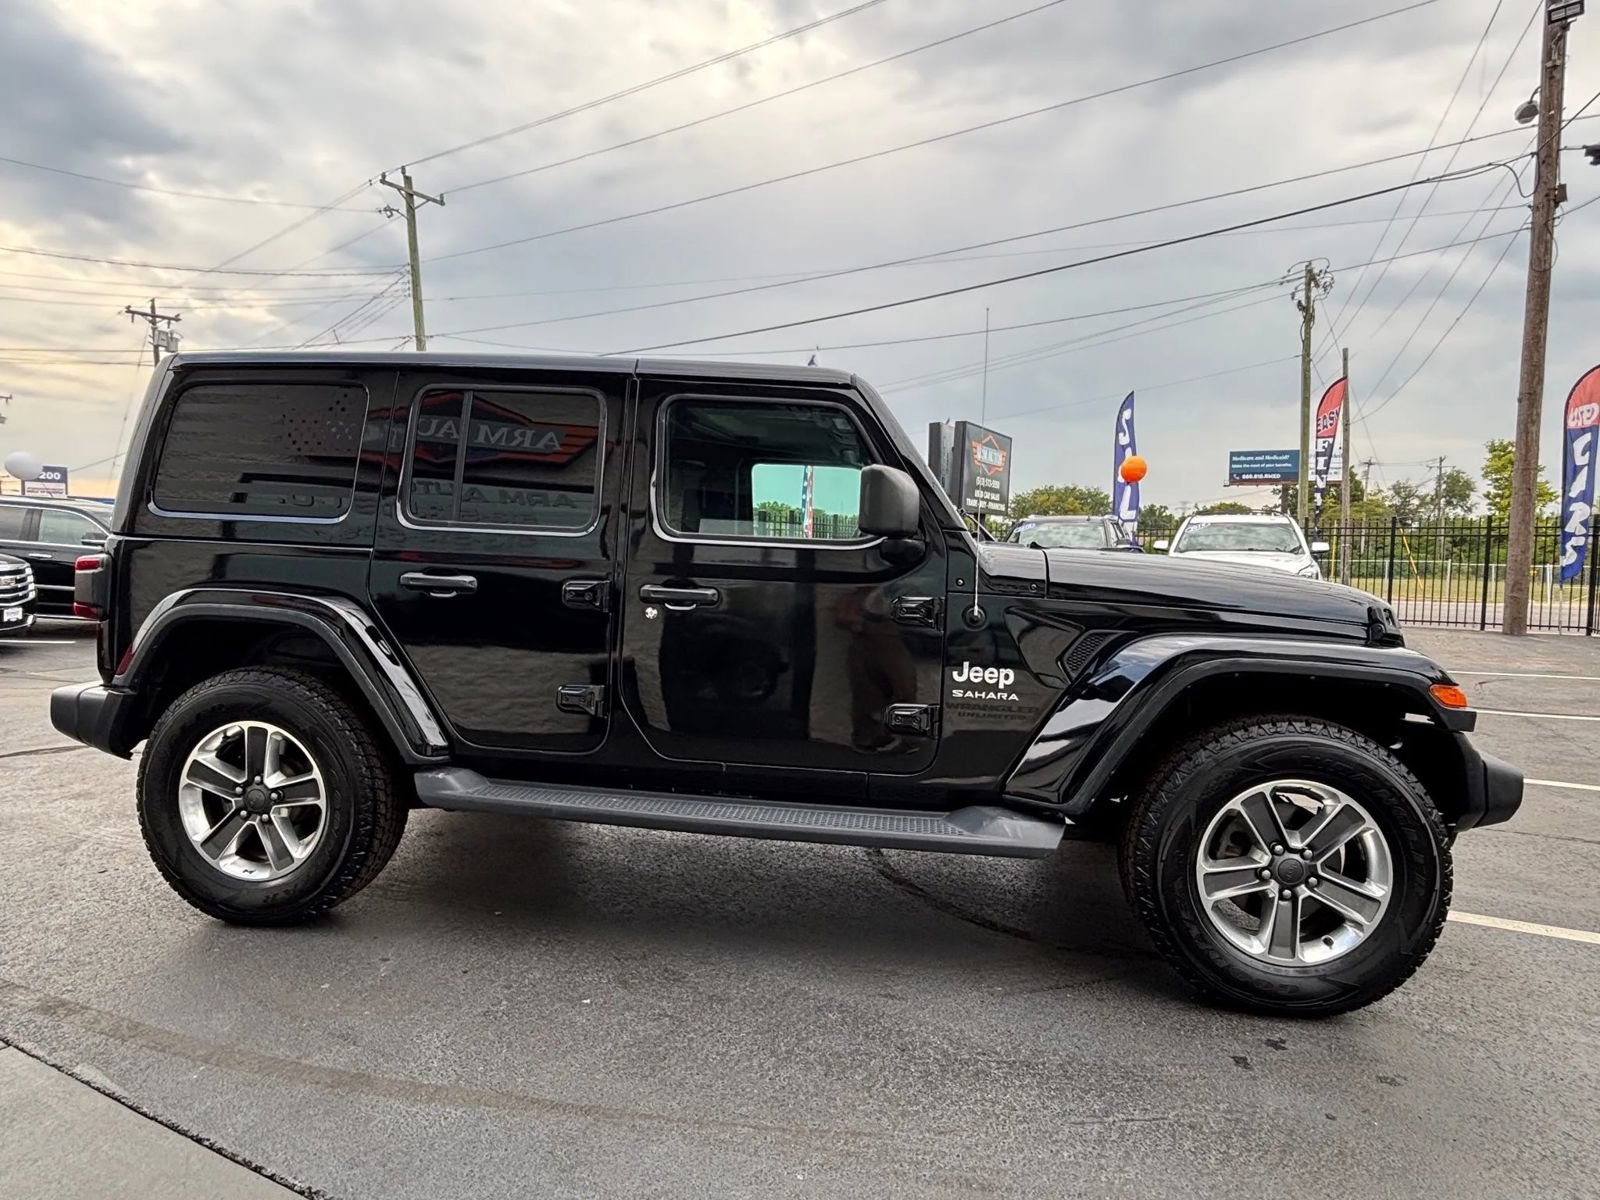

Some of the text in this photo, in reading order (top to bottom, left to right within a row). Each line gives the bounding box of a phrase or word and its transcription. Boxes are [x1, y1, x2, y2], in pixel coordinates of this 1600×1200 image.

[1316, 407, 1340, 433] EASY
[952, 661, 1015, 689] Jeep
[952, 689, 1019, 701] SAHARA
